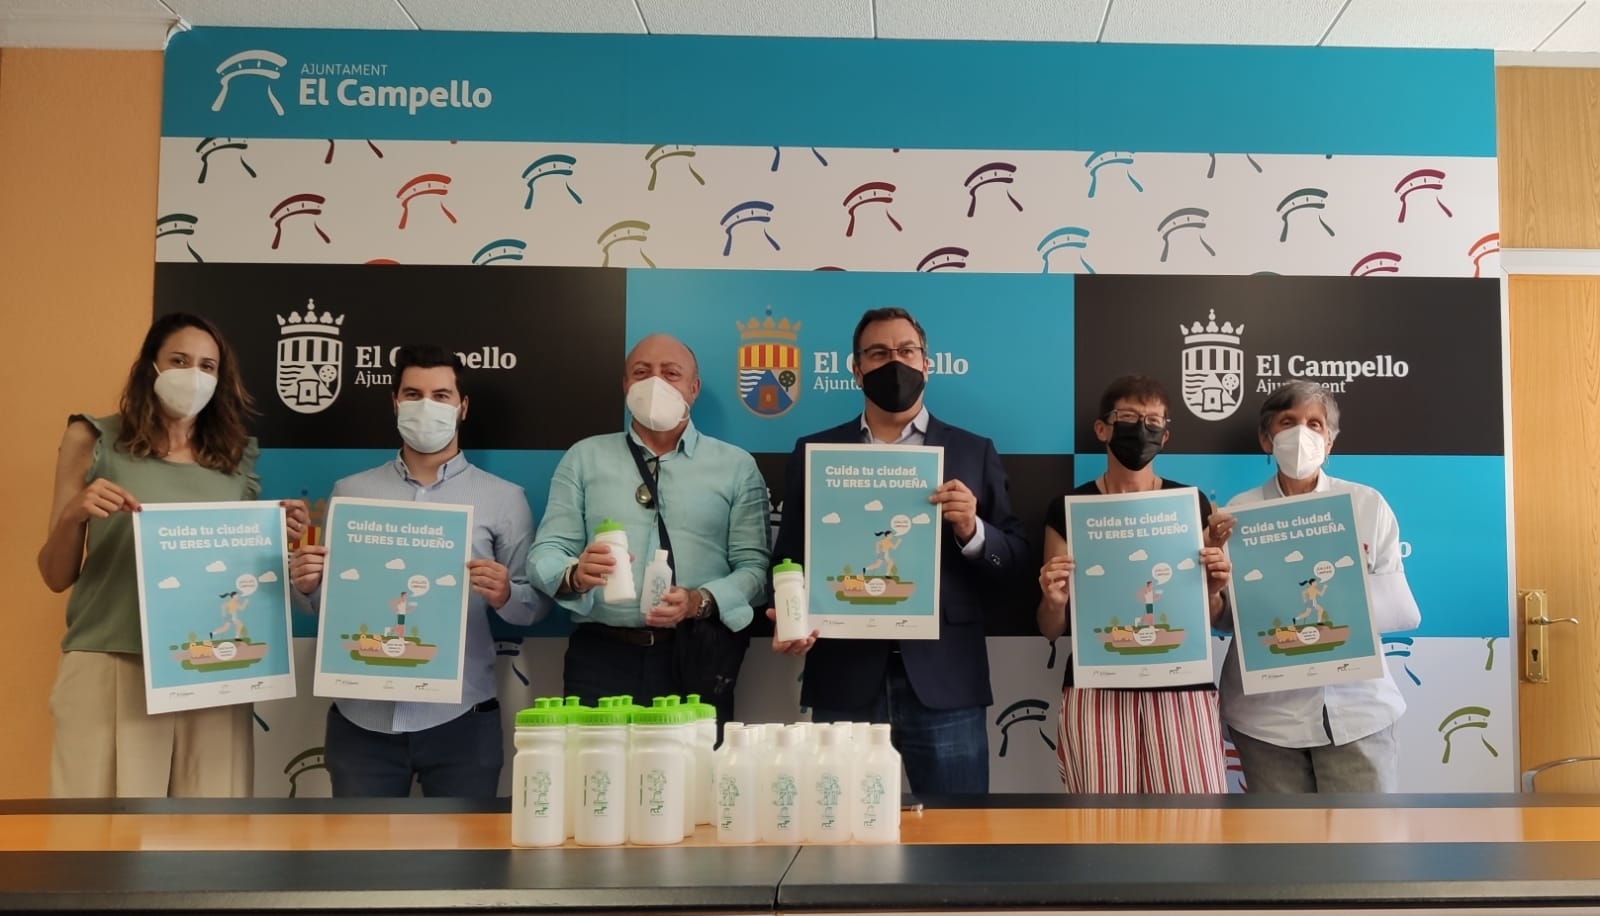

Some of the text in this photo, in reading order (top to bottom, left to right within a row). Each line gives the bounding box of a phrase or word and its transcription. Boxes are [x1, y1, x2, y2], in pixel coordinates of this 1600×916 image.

[300, 63, 388, 76] AJUNTAMENT
[299, 77, 492, 115] El Campello
[355, 345, 382, 368] El
[813, 351, 839, 374] El
[1256, 354, 1409, 382] El Campello
[825, 465, 860, 476] Cuida
[862, 466, 874, 476] tu
[825, 477, 928, 488] TU ERES LA DUEÑA
[347, 520, 383, 532] Cuida
[385, 522, 398, 533] tu
[1086, 517, 1122, 528] Cuida
[1124, 516, 1137, 526] tu
[1241, 522, 1274, 535] Cuida
[1276, 519, 1289, 529] tu
[158, 526, 197, 537] Cuida
[200, 525, 214, 536] tu
[1087, 522, 1188, 540] TU ERES EL DUEÑO
[1242, 522, 1346, 547] TU ERES LA DUEÑA
[160, 536, 272, 550] TU ERES LA DUEÑA
[347, 533, 455, 549] TU ERES EL DUEÑO
